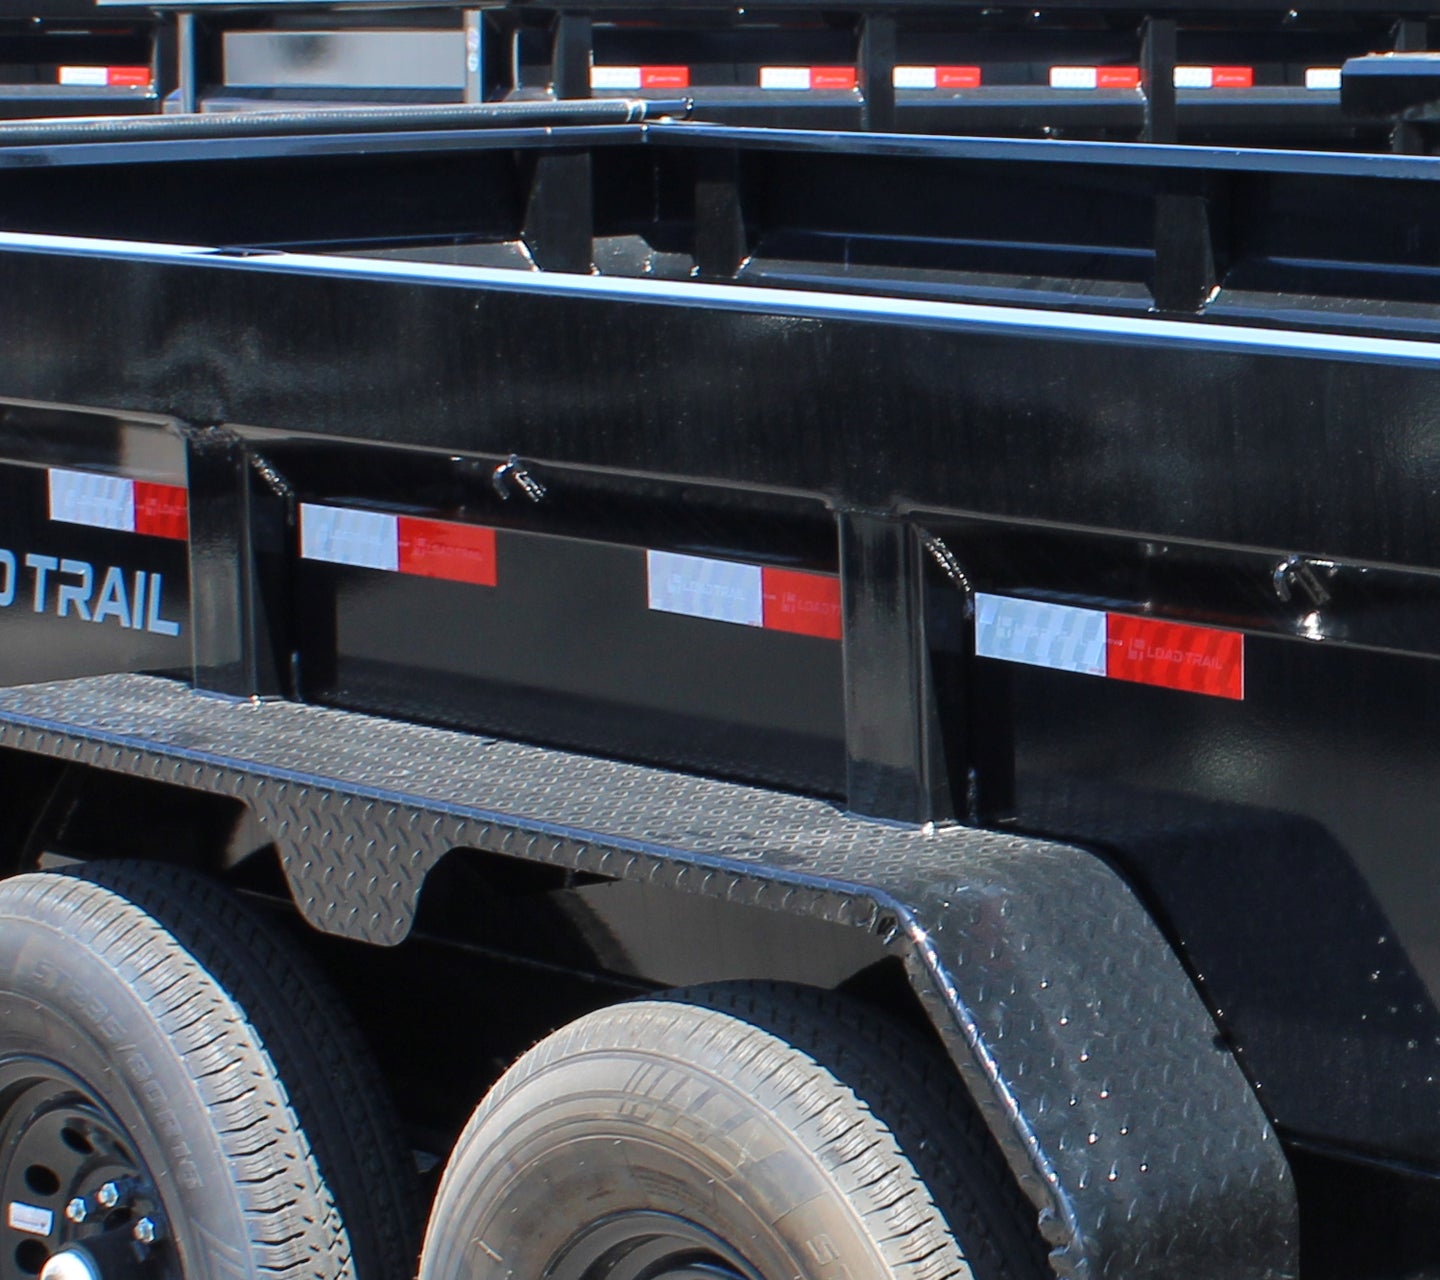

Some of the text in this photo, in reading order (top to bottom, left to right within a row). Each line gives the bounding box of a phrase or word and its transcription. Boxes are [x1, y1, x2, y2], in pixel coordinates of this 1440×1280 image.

[24, 552, 181, 638] TRAIL
[1146, 646, 1223, 670] LOAD TRAIL
